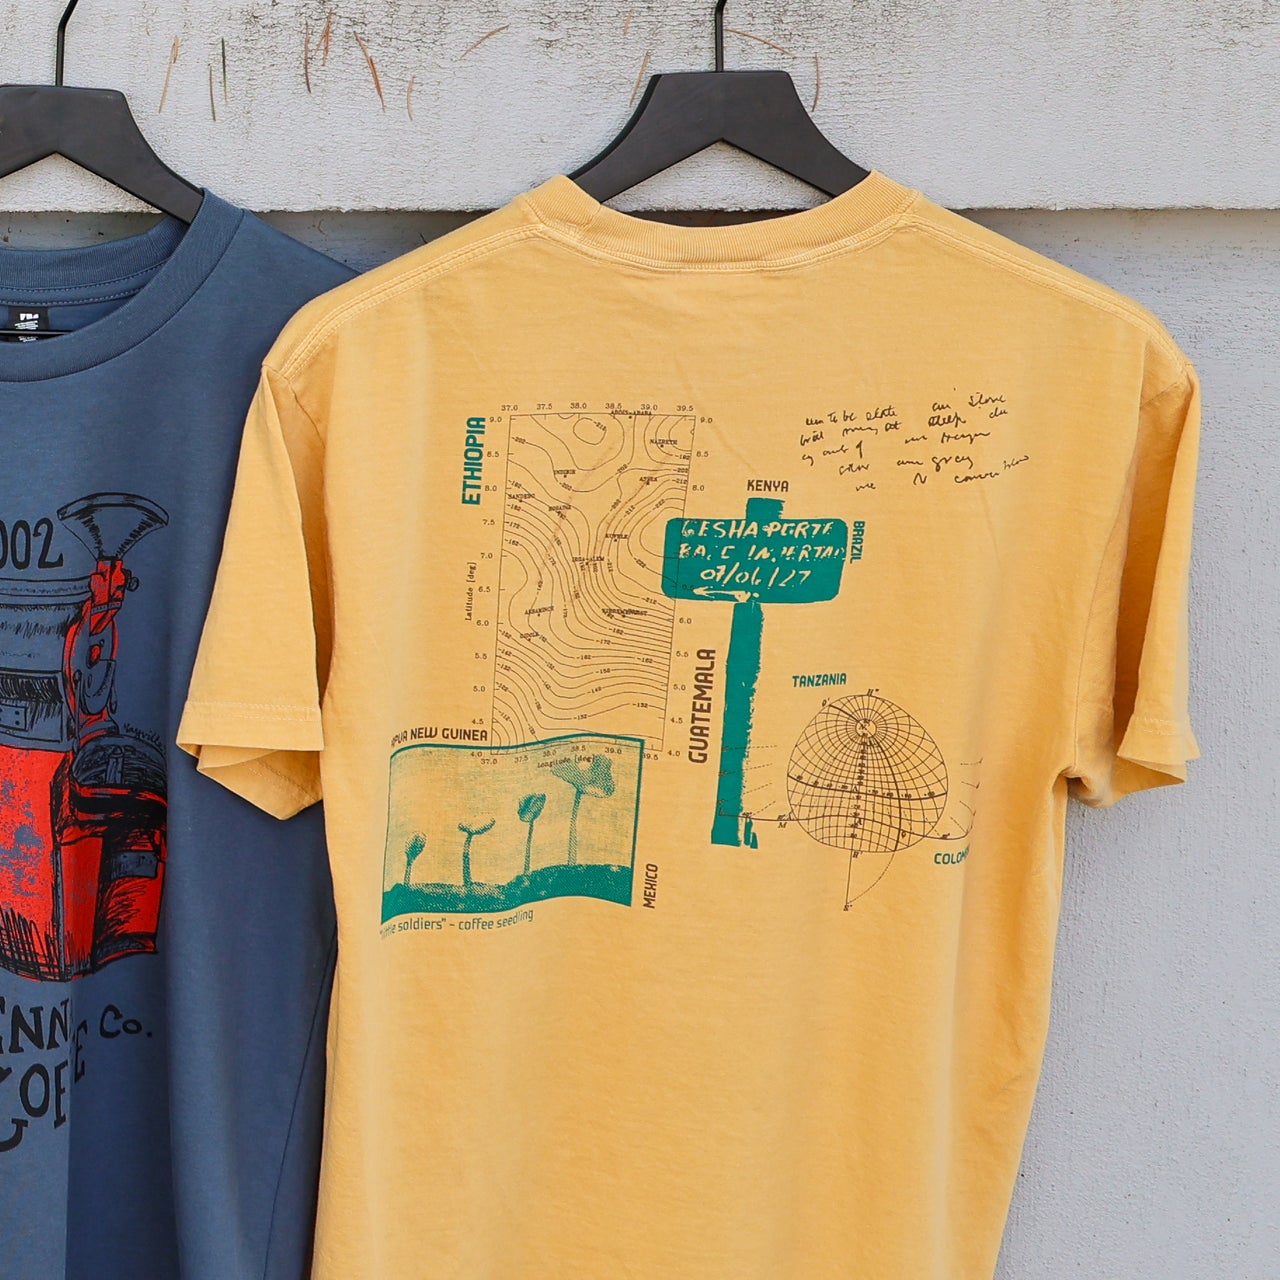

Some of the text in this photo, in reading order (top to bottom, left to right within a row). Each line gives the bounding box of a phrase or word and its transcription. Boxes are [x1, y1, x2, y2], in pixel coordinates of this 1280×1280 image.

[605, 402, 623, 410] 38.5
[461, 416, 486, 506] ETHIOPIA
[746, 479, 789, 493] KENYA
[849, 520, 866, 564] BRAZIL
[465, 587, 473, 621] Latitude
[792, 673, 847, 688] TANZANIA
[473, 685, 486, 693] 5.0
[688, 648, 716, 764] GUATEMALA
[410, 727, 438, 740] NEW
[441, 727, 488, 741] GUINEA
[605, 747, 622, 755] 39.0
[667, 749, 681, 757] 4.0
[643, 863, 659, 909] MEXICO
[458, 917, 494, 931] coffee
[497, 909, 534, 928] seedling
